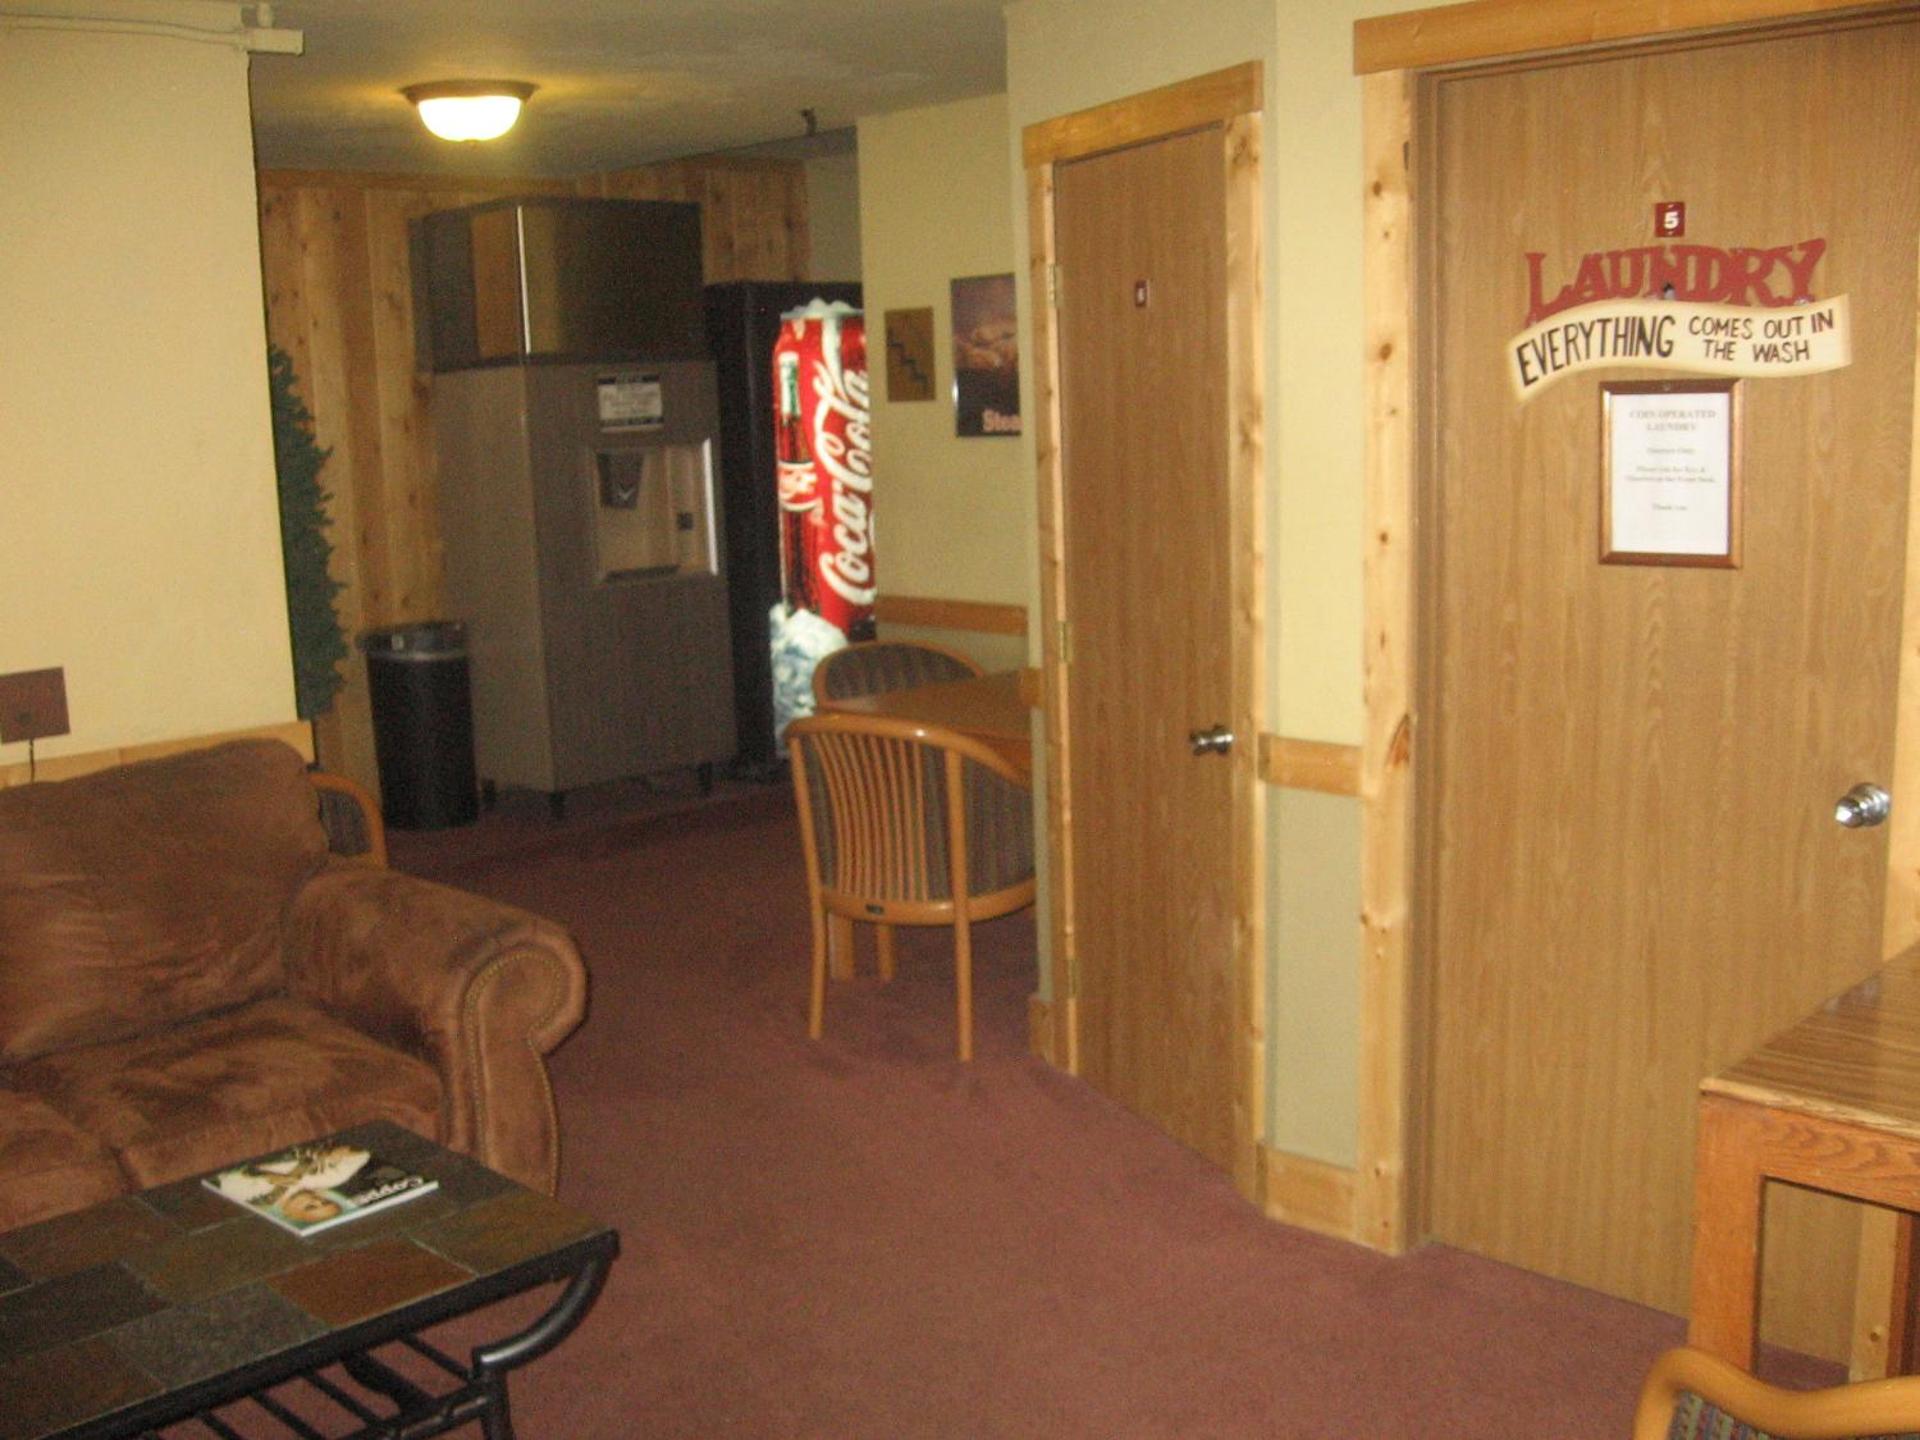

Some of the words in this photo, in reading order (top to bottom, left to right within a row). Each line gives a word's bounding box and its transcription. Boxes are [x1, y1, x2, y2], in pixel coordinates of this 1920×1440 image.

[1663, 211, 1680, 230] 5
[1525, 238, 1827, 330] LAUNDRY
[1516, 315, 1676, 387] EVERYTHING
[1688, 315, 1753, 340] COMES
[1763, 316, 1804, 339] OUT
[1811, 308, 1834, 334] IN
[1703, 338, 1736, 361] THE
[1752, 339, 1810, 363] WASH
